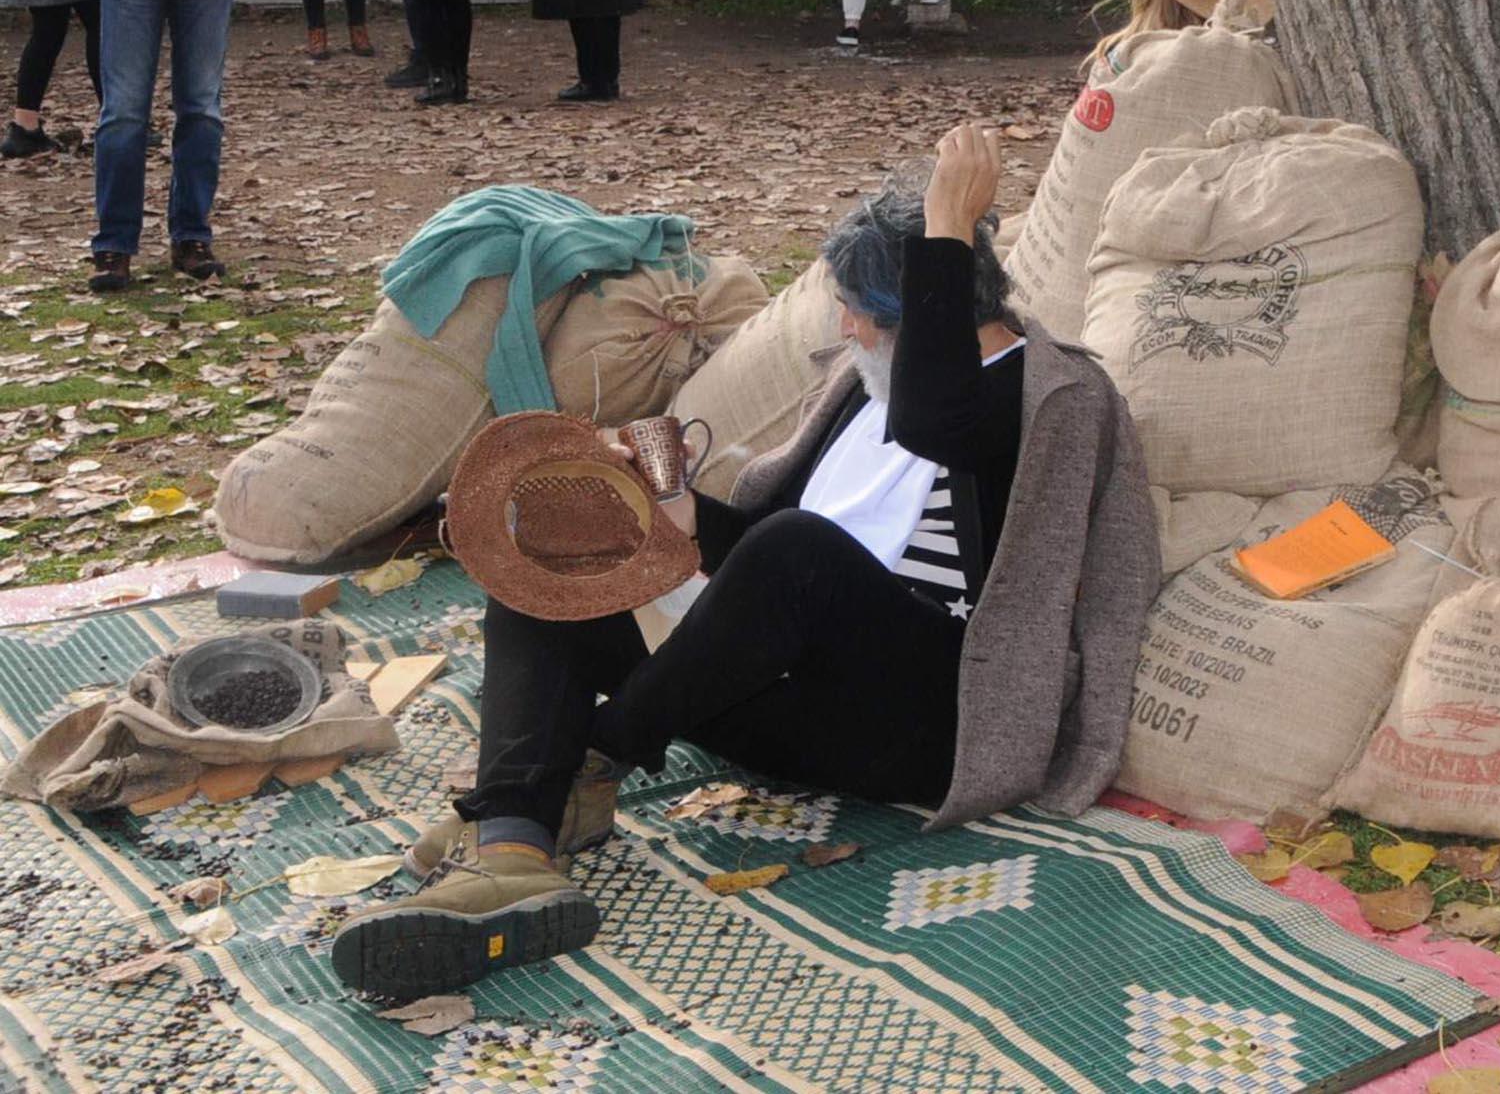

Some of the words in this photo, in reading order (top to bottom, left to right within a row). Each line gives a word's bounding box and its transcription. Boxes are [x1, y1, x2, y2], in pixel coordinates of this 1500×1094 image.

[1141, 330, 1176, 352] ECOM
[1234, 329, 1280, 351] TRADING
[1206, 605, 1258, 631] BEANS
[1184, 649, 1247, 683] 10/2020
[1220, 635, 1278, 667] BRAZIL
[1152, 663, 1210, 700] 10/2023
